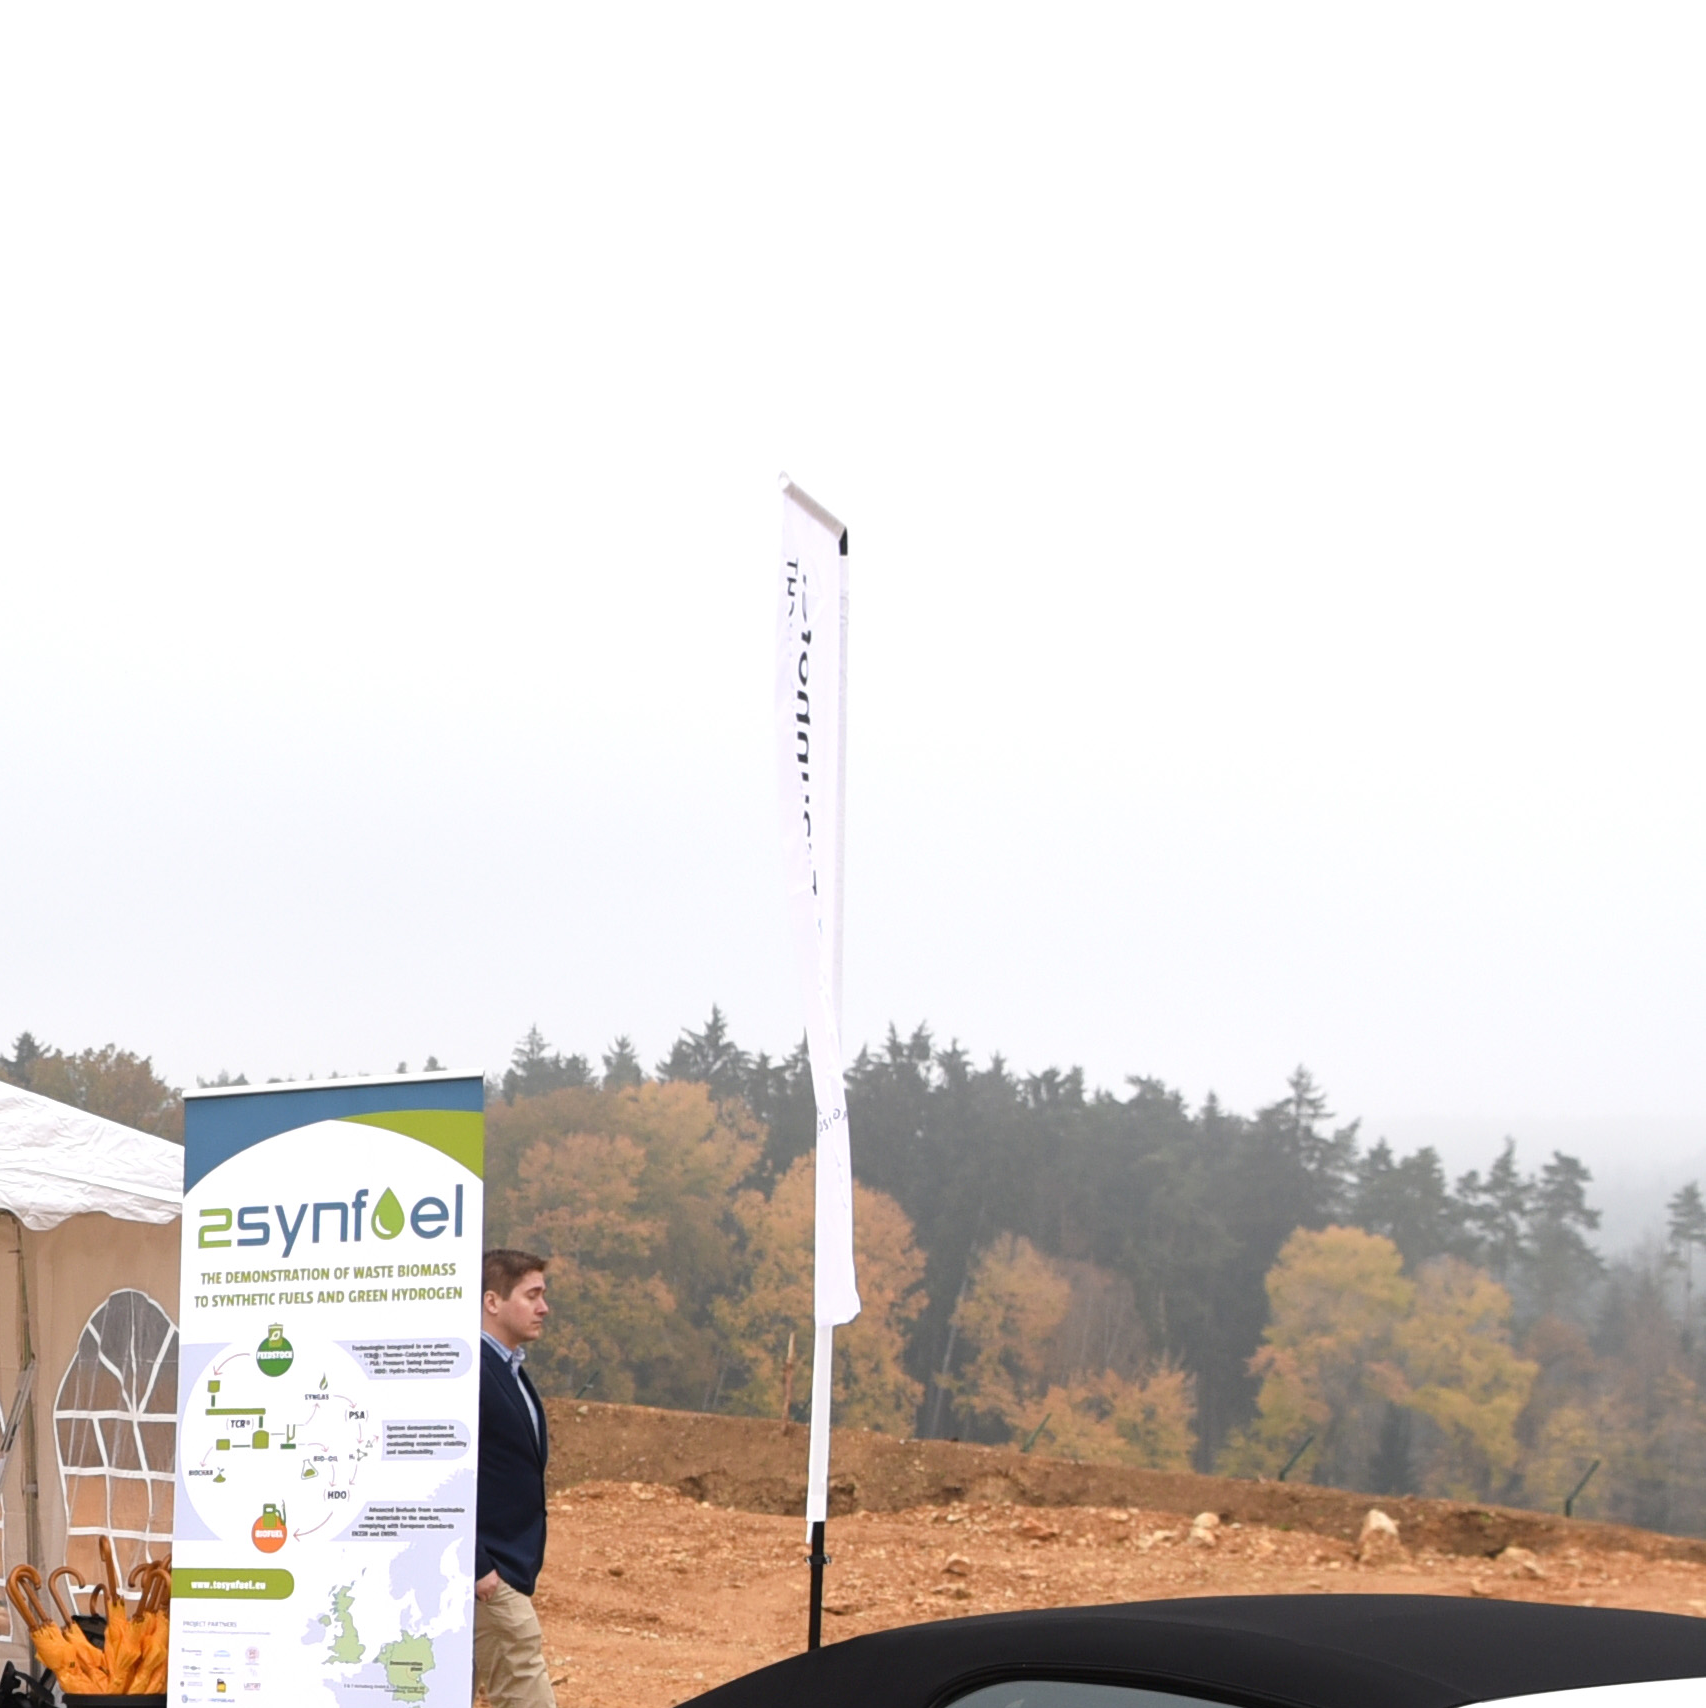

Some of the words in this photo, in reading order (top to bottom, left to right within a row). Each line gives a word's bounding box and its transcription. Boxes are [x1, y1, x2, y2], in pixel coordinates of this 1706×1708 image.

[200, 1271, 223, 1285] THE
[225, 1267, 330, 1284] DEMONSTRATION
[333, 1267, 350, 1280] OF
[353, 1265, 394, 1280] WASTE
[397, 1262, 457, 1278] BIOMASS
[194, 1295, 209, 1309] TO
[211, 1292, 276, 1308] SYNTHETIC
[278, 1291, 314, 1306] FUELS
[317, 1290, 345, 1304] AND
[348, 1289, 389, 1304] GREEN
[391, 1286, 463, 1302] HYDROGEN
